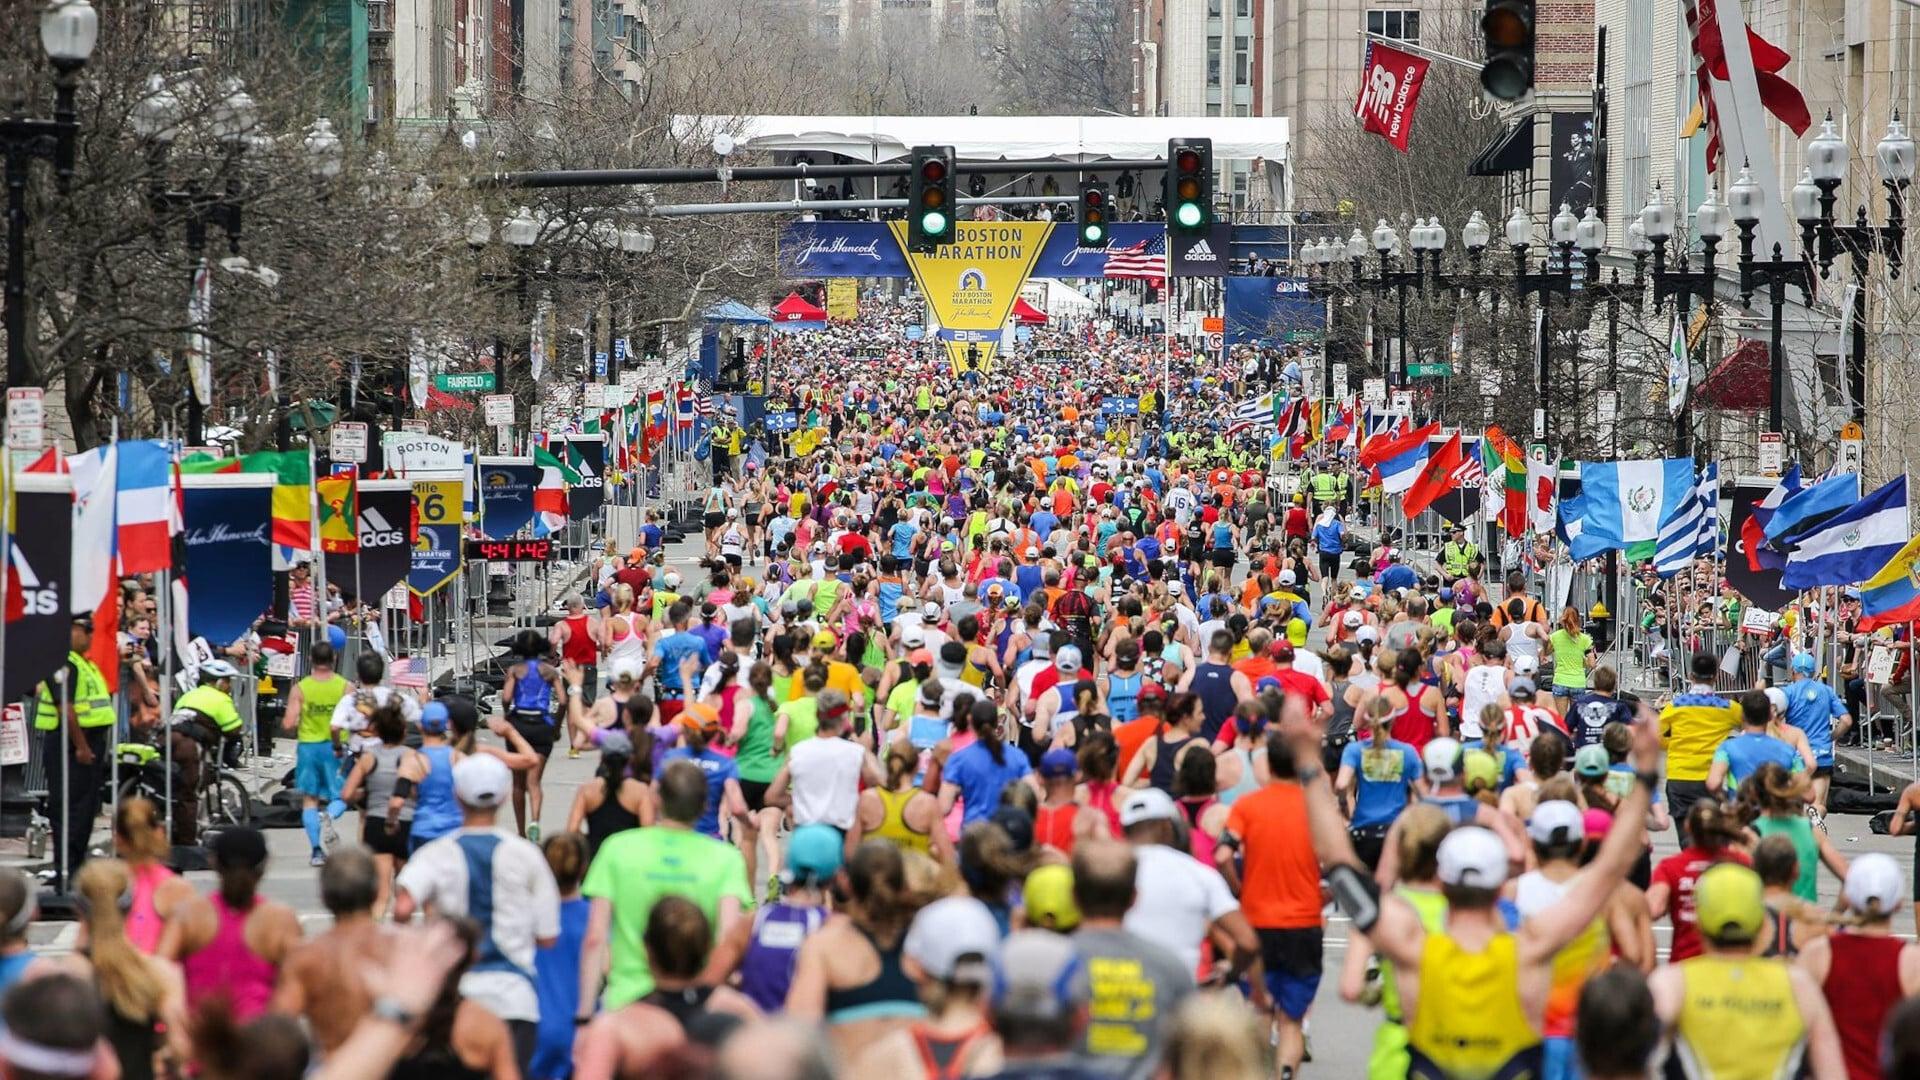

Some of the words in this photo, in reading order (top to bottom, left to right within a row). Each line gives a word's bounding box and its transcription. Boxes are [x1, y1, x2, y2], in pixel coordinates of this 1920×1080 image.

[1394, 65, 1416, 112] balance
[1389, 111, 1403, 138] new
[957, 228, 1022, 242] BOSTON
[796, 236, 830, 265] John
[829, 234, 881, 261] Hancock
[1184, 251, 1216, 261] adidas
[447, 376, 484, 388] FAIRFIELD
[1115, 399, 1125, 413] 3
[775, 414, 784, 428] 3
[397, 442, 450, 455] BOSTON
[413, 482, 438, 494] Mile
[493, 483, 528, 491] MARATHON
[1174, 496, 1186, 509] 16
